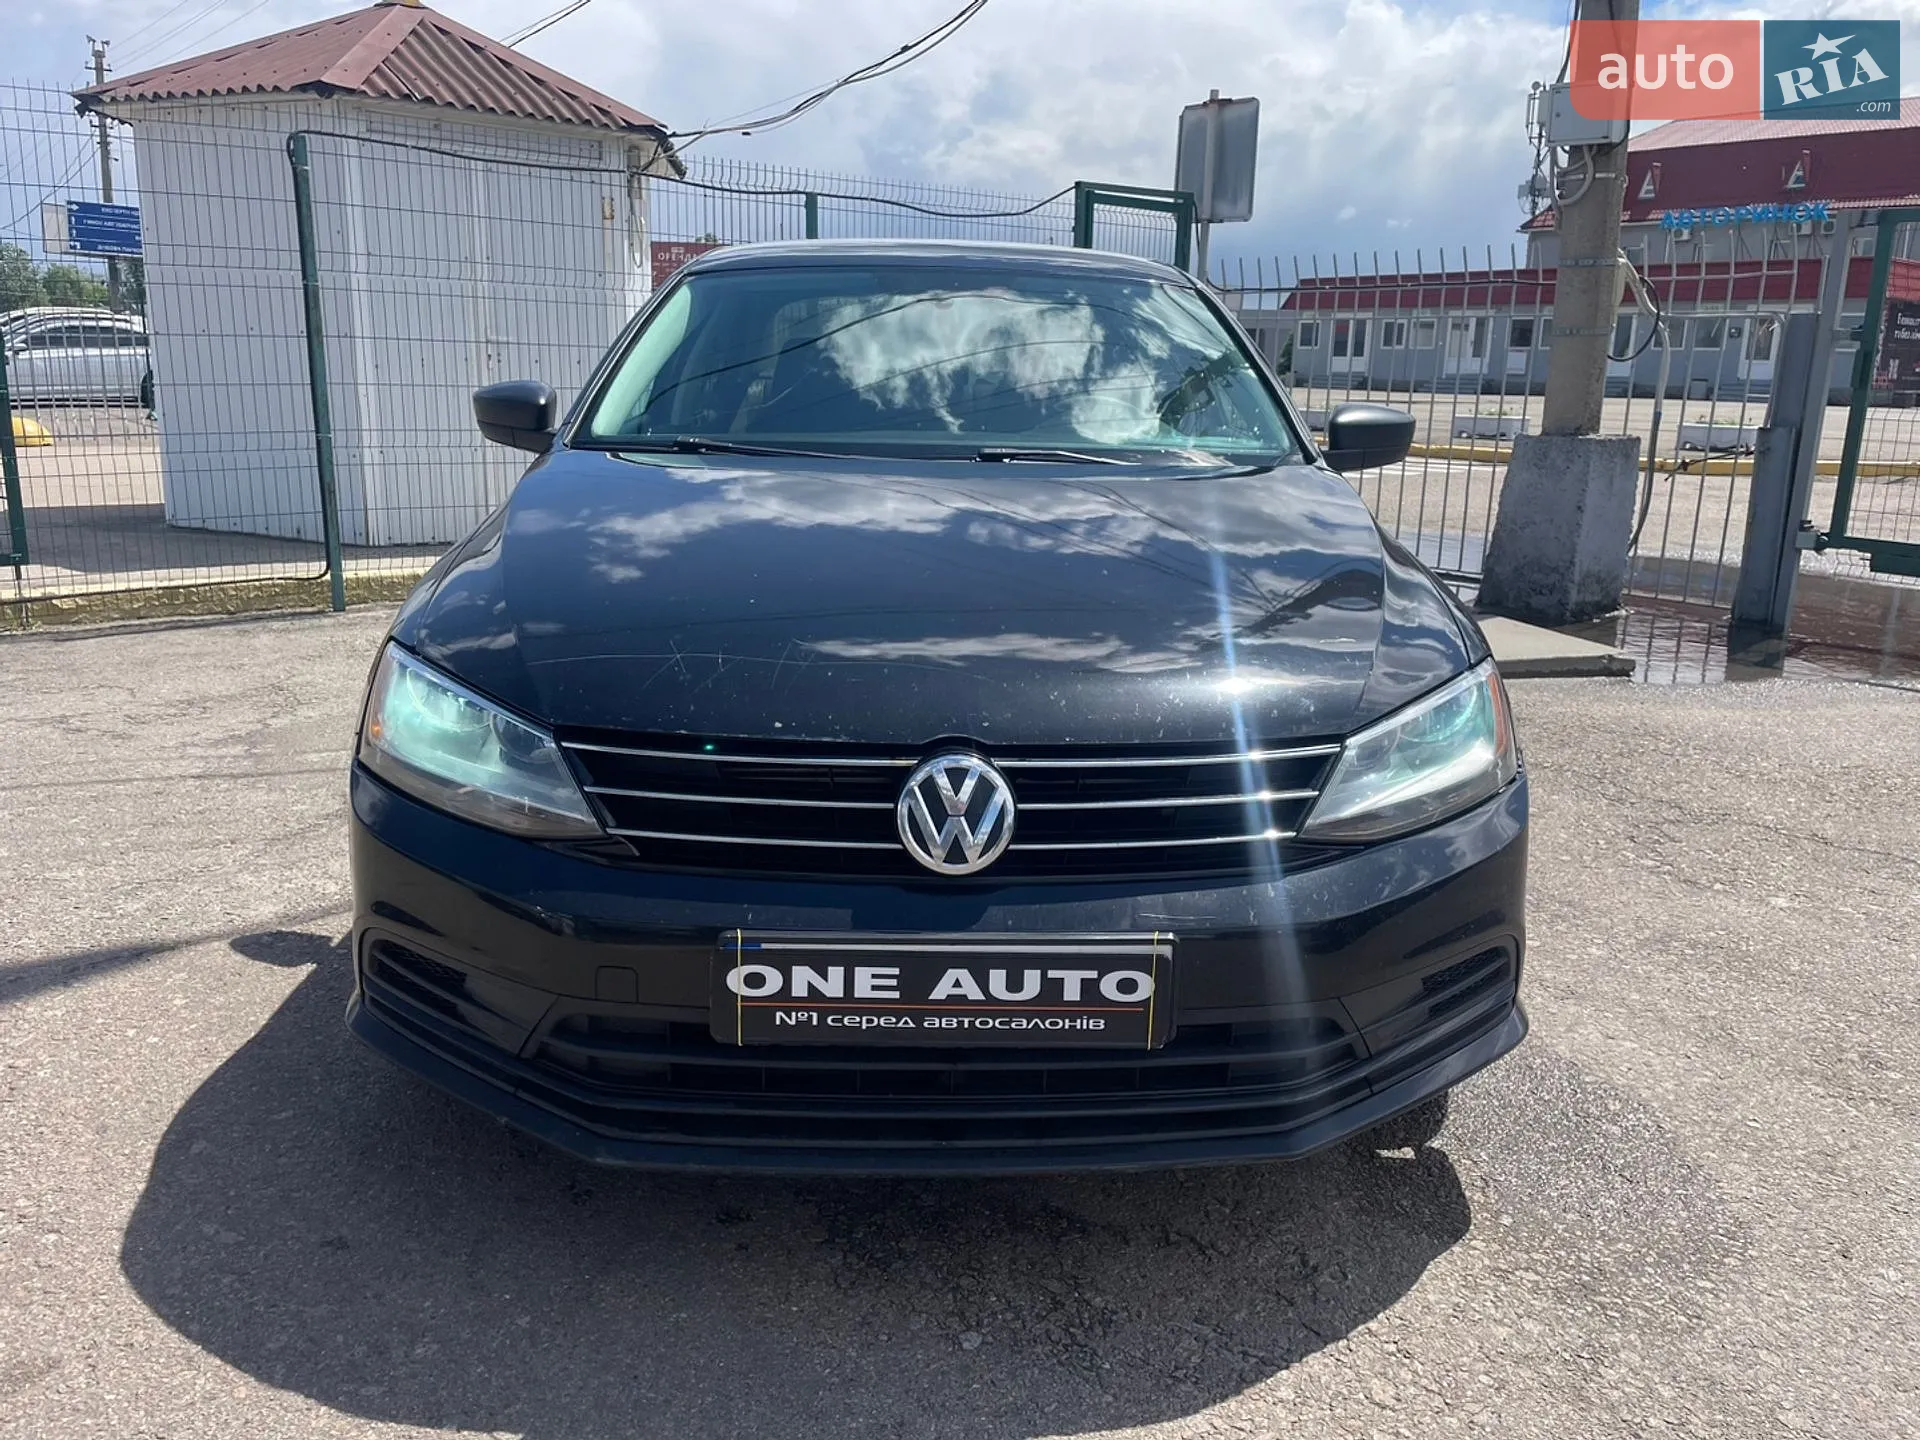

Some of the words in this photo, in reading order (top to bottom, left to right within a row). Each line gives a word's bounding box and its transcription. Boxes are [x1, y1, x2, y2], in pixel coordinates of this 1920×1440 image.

[725, 965, 900, 998] ONE
[928, 969, 1156, 1002] AUTO
[775, 1010, 818, 1026] №1
[827, 1015, 917, 1030] серед
[923, 1015, 1105, 1031] автосалонів
